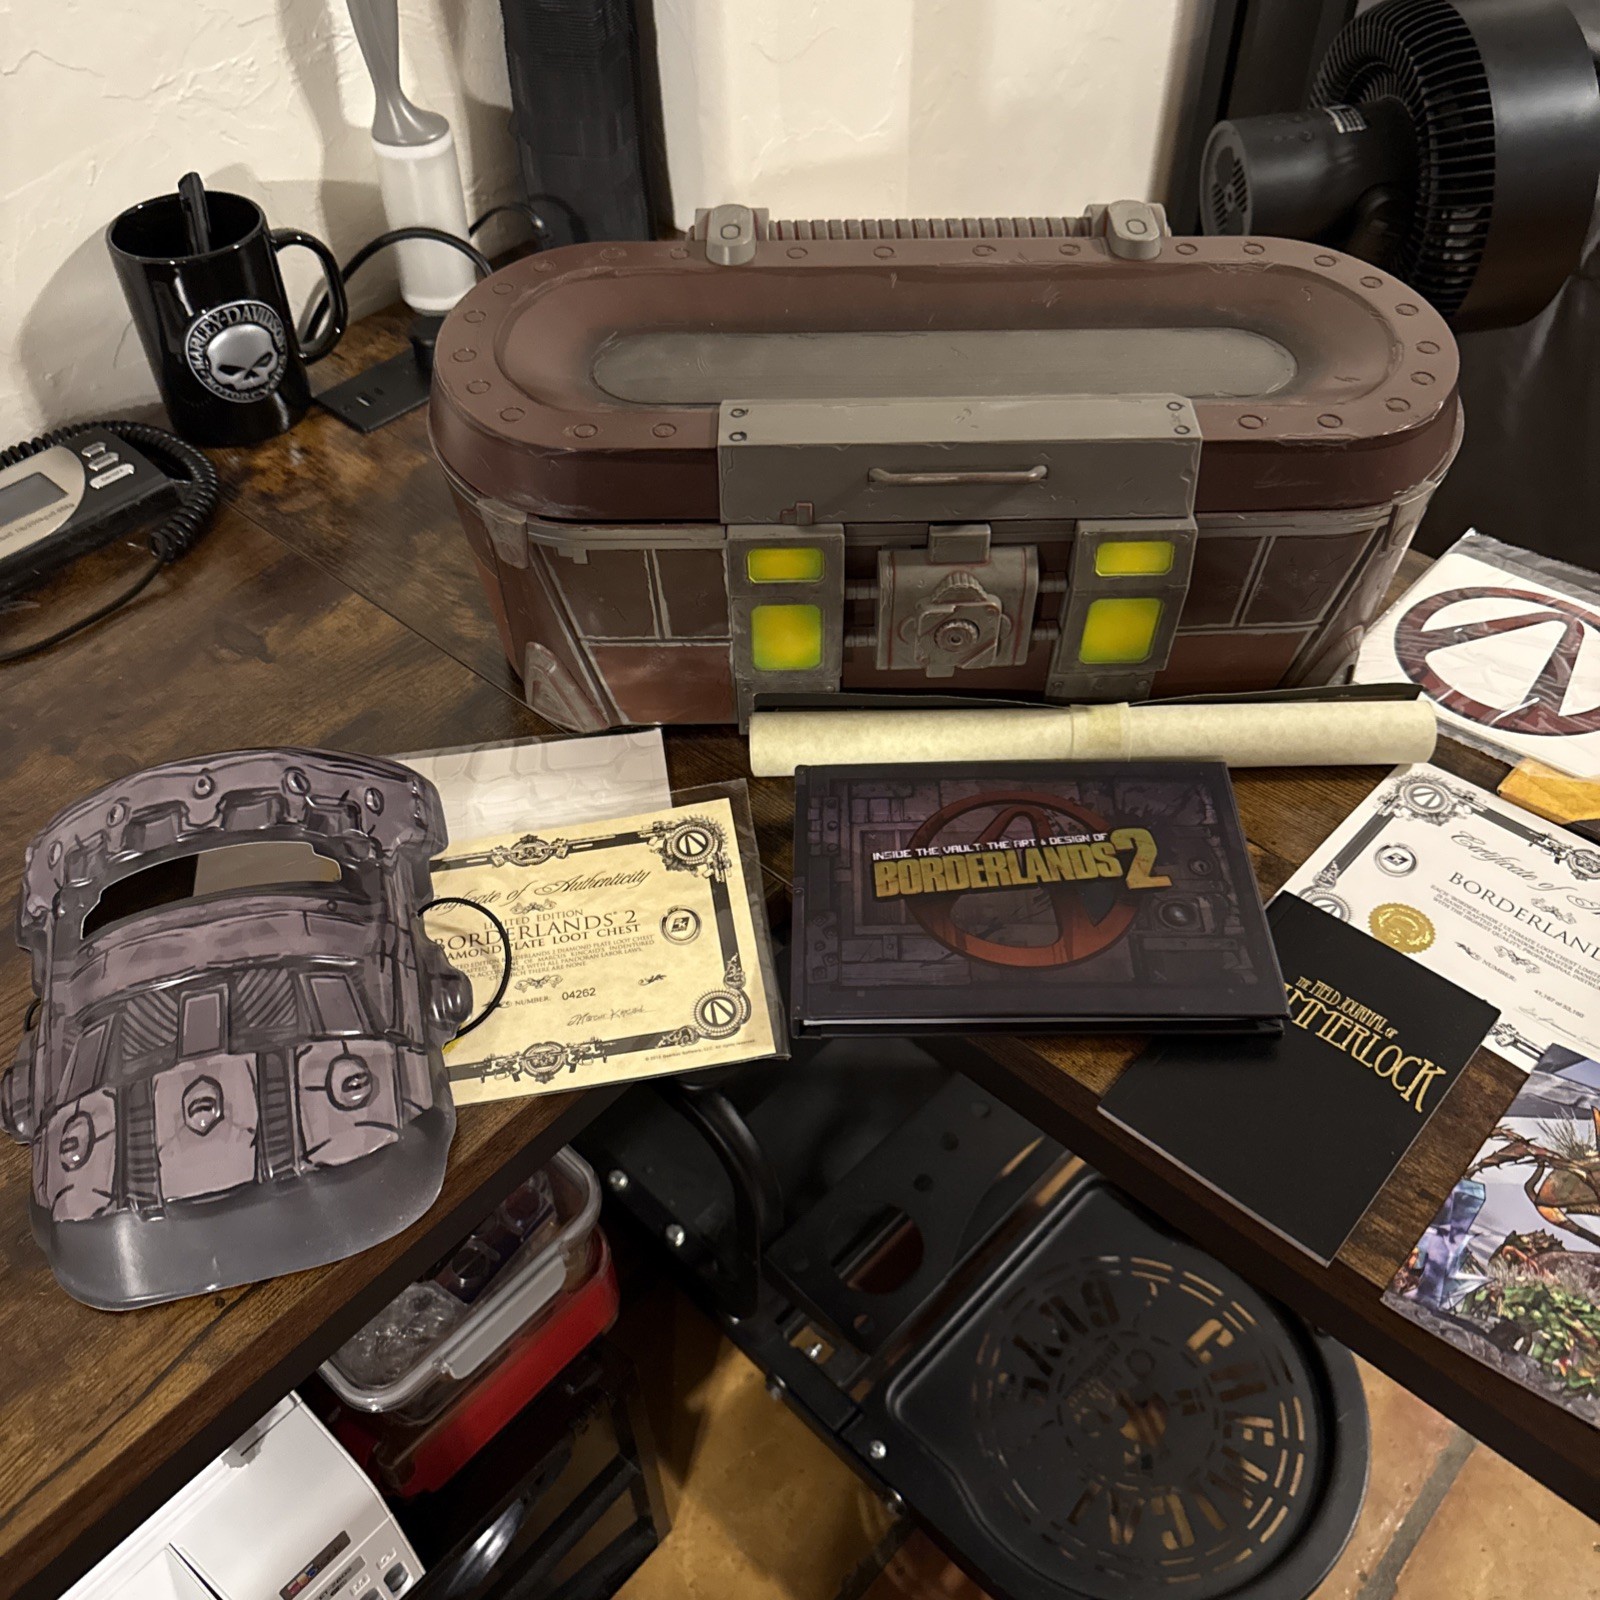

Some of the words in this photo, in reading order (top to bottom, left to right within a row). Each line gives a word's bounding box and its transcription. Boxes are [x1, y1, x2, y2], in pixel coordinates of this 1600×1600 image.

[872, 849, 911, 861] INSIDE
[915, 846, 940, 857] THE
[986, 839, 1009, 850] THE
[1012, 837, 1037, 848] ART
[1049, 834, 1090, 846] DESIGN
[1093, 832, 1109, 843] OF
[874, 842, 1123, 898] BORDERLANDS
[1110, 827, 1173, 890] 2
[1451, 831, 1536, 888] Certificate
[534, 870, 651, 901] Authenticity
[536, 909, 583, 922] EDITION
[624, 909, 637, 924] 2
[446, 943, 502, 962] AMOND
[553, 931, 588, 945] LOOT
[596, 923, 641, 938] CHEST
[561, 987, 596, 1001] 04262
[1295, 976, 1313, 991] THE
[1309, 980, 1341, 1006] FIELD
[1337, 997, 1388, 1034] JOURNAL
[1284, 982, 1447, 1113] MMERLOCK
